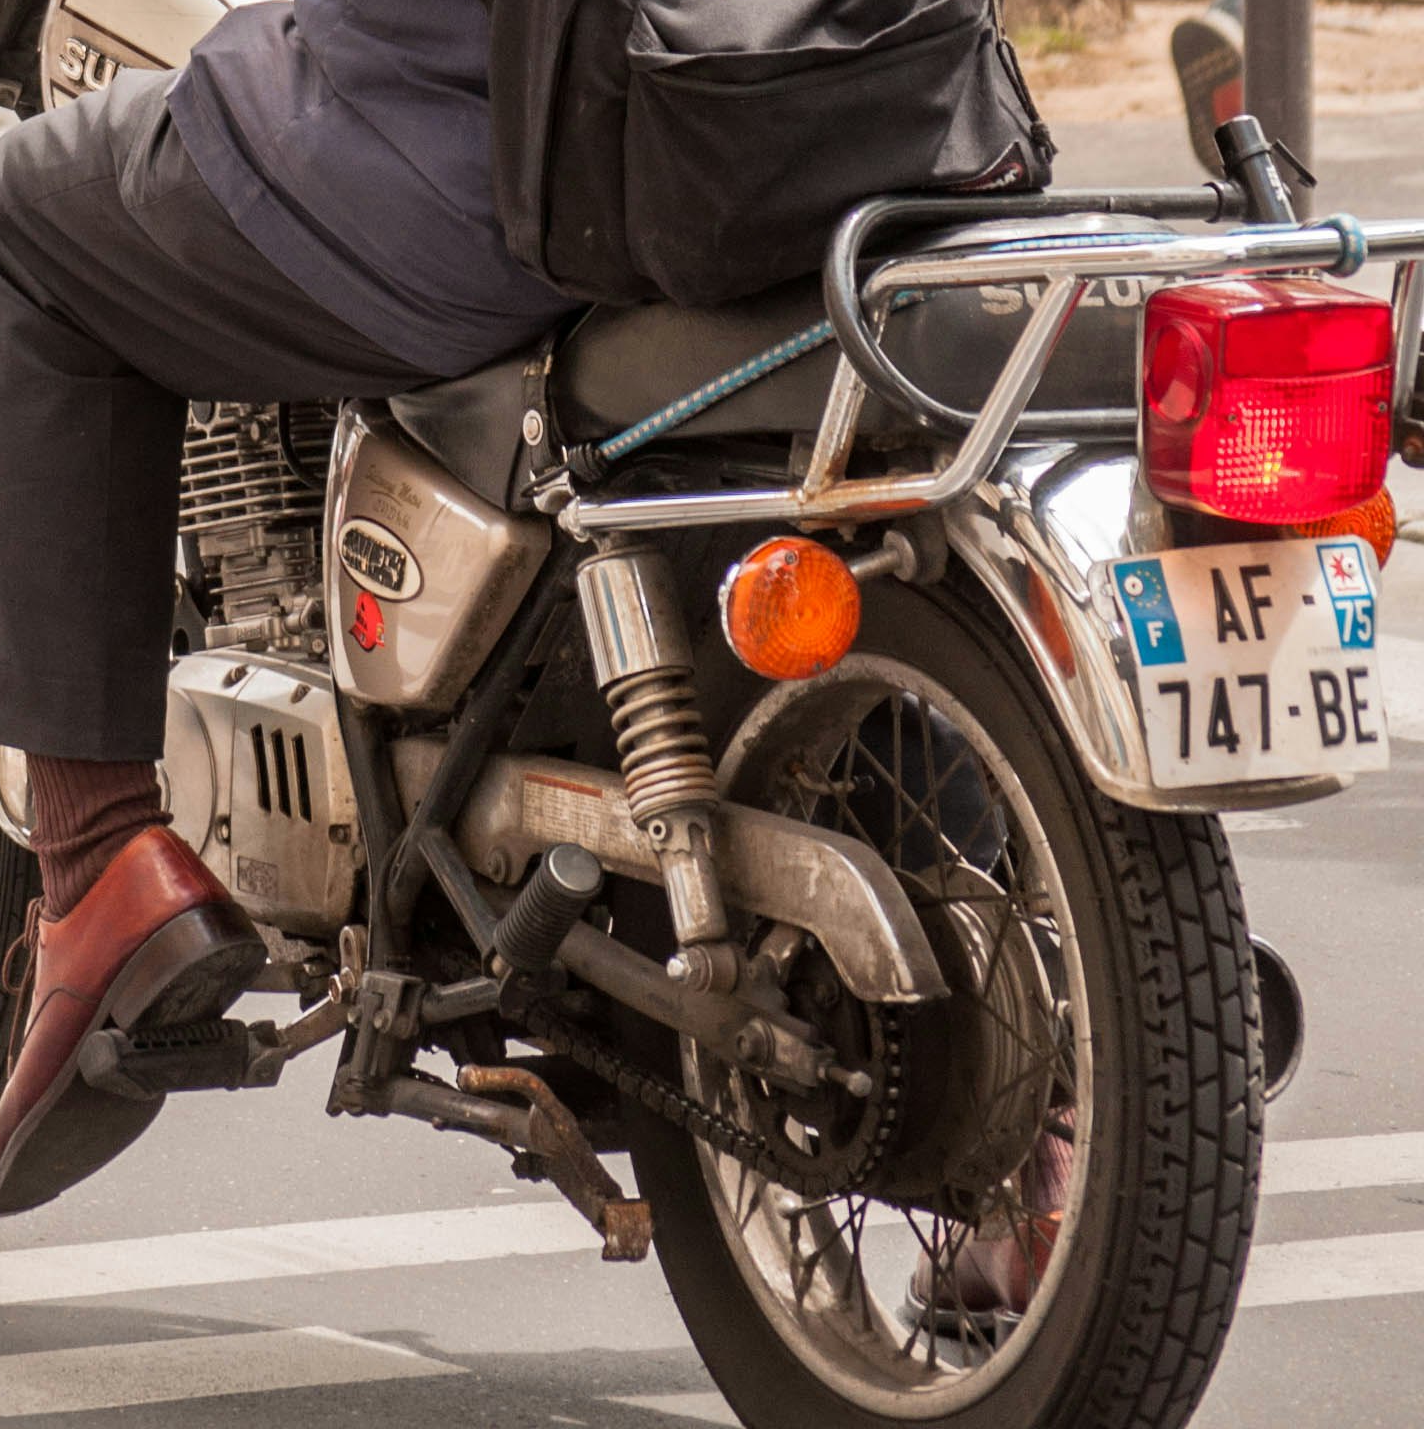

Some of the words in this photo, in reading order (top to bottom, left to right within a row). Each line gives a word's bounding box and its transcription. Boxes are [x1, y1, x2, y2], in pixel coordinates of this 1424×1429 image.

[57, 37, 117, 91] SU
[1146, 621, 1164, 648] F
[1334, 599, 1372, 643] 75
